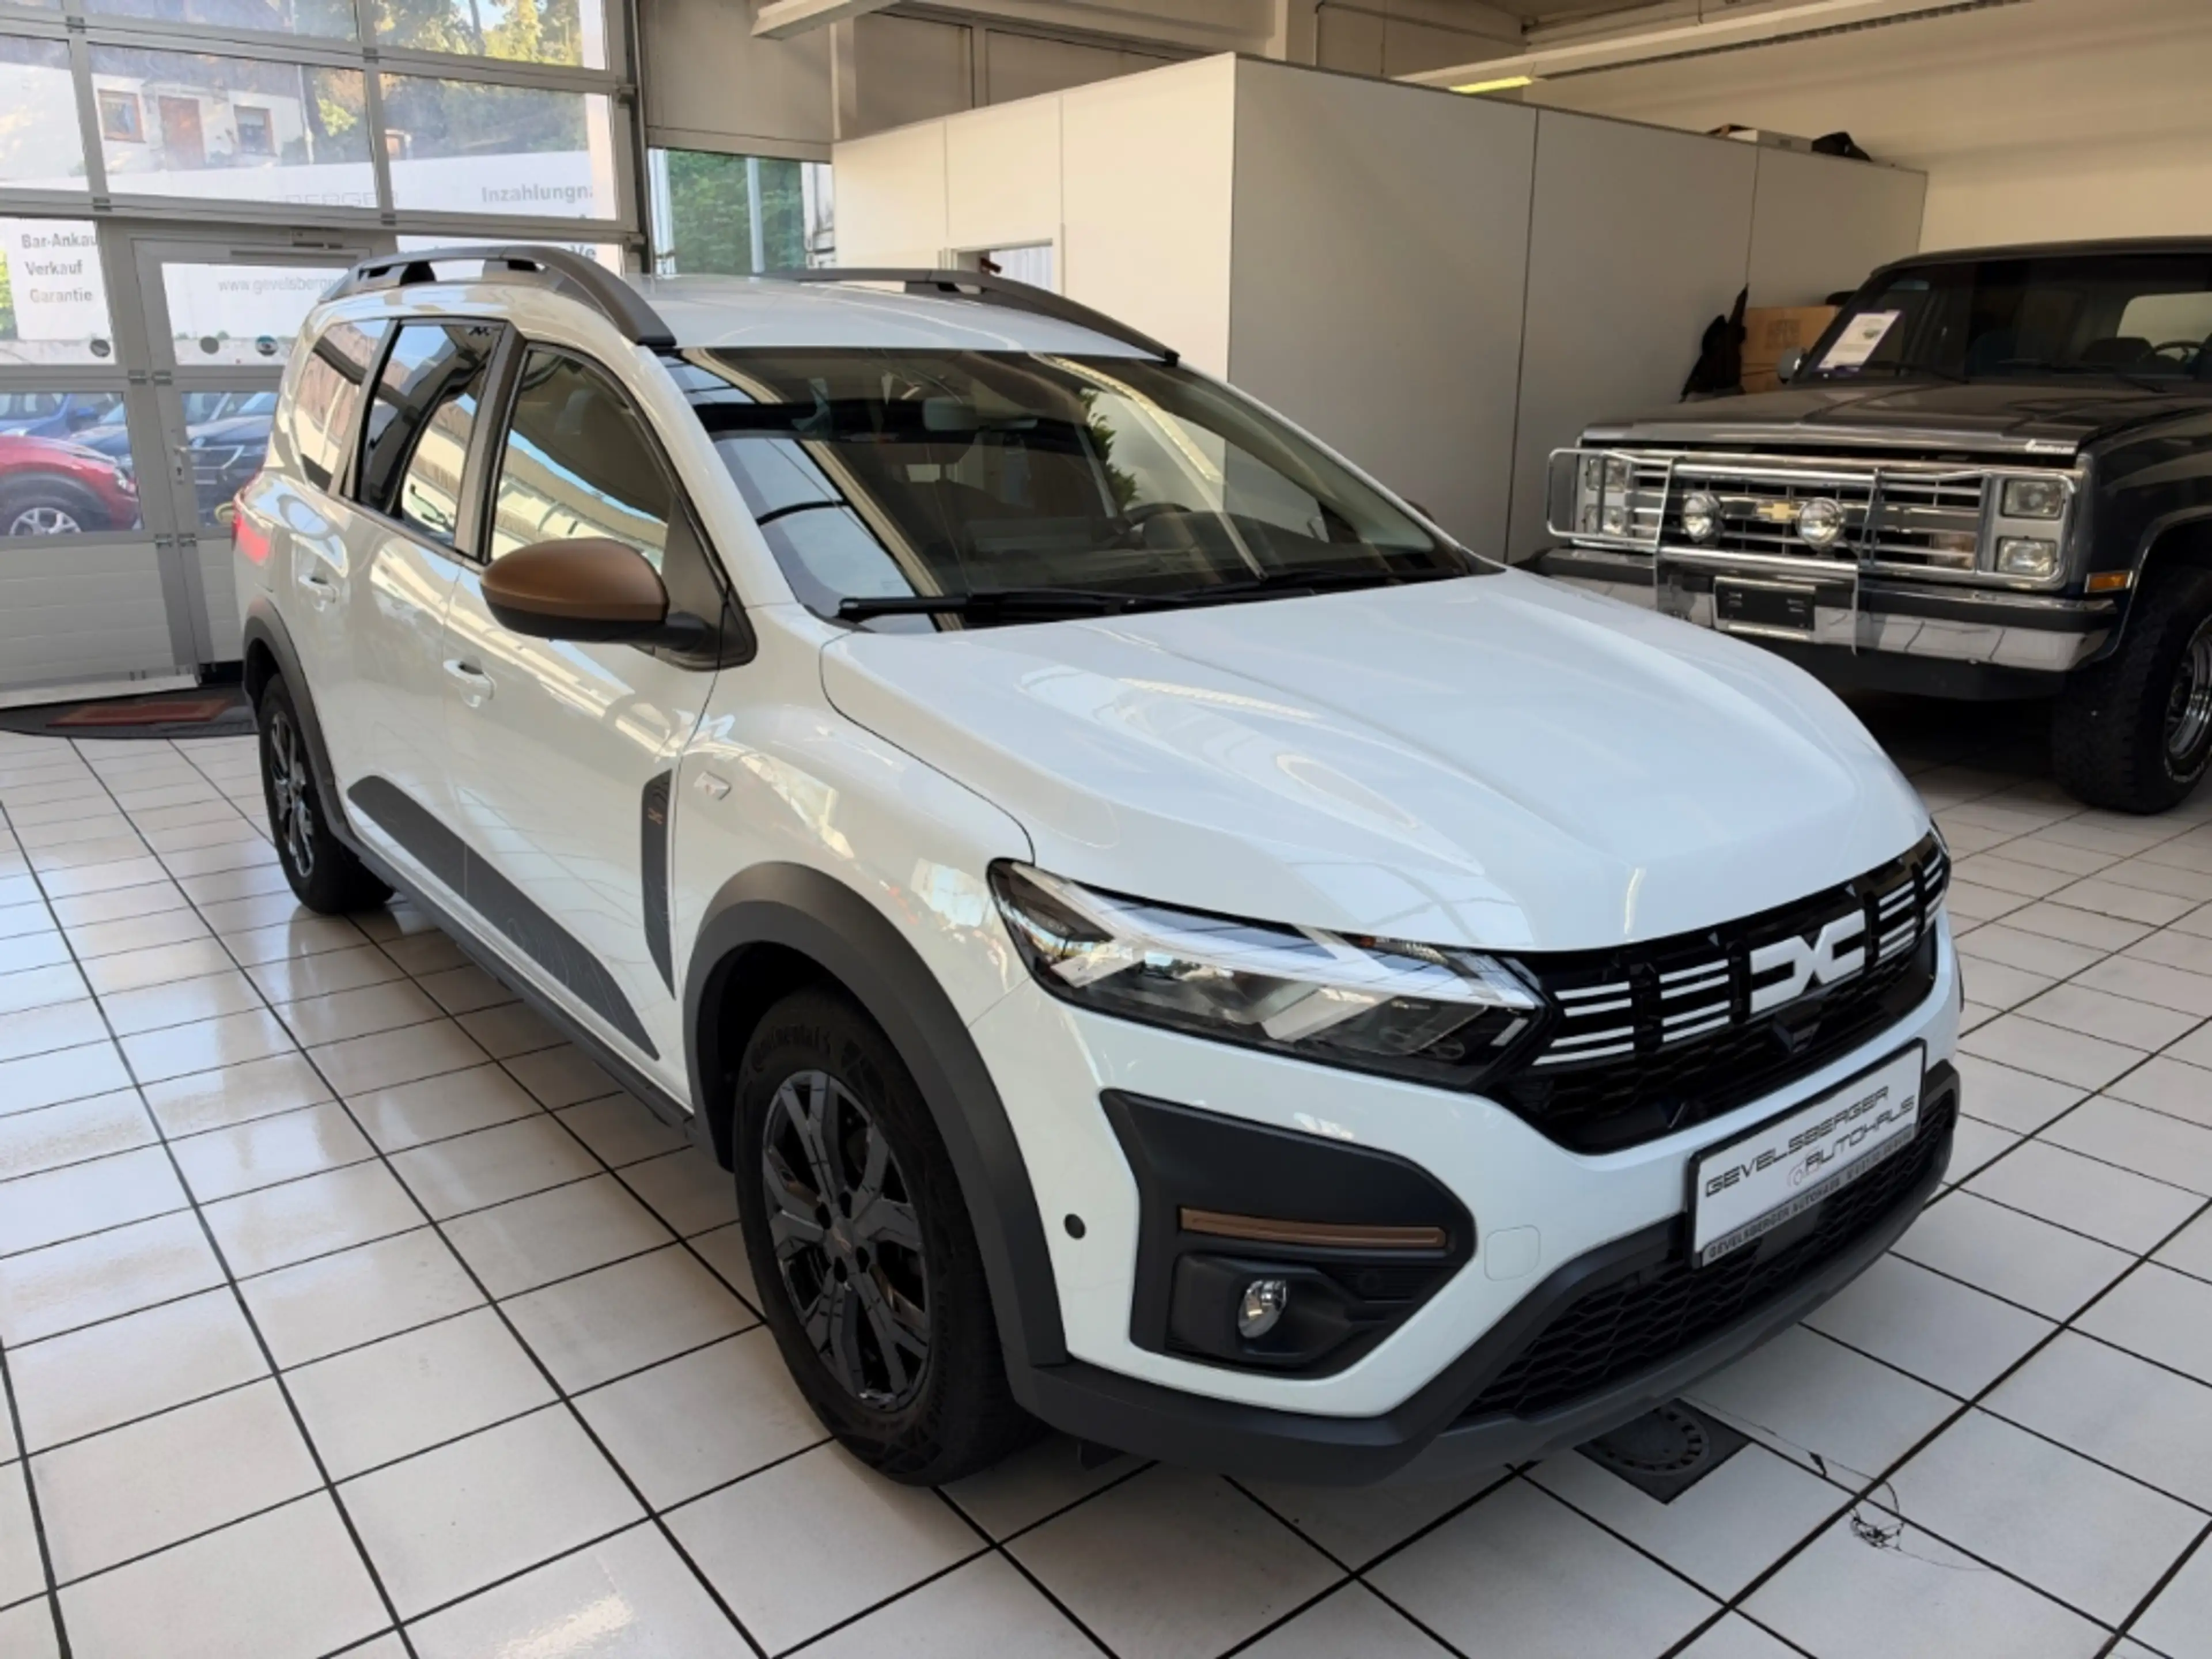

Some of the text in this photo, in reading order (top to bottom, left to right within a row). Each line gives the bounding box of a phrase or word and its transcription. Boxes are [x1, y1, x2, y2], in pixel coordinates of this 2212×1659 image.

[24, 259, 83, 276] Verkauf
[29, 287, 92, 303] Garantie
[1705, 1085, 1889, 1198] GEVELSBERGER
[1804, 1095, 1915, 1173] AUTOHAUS
